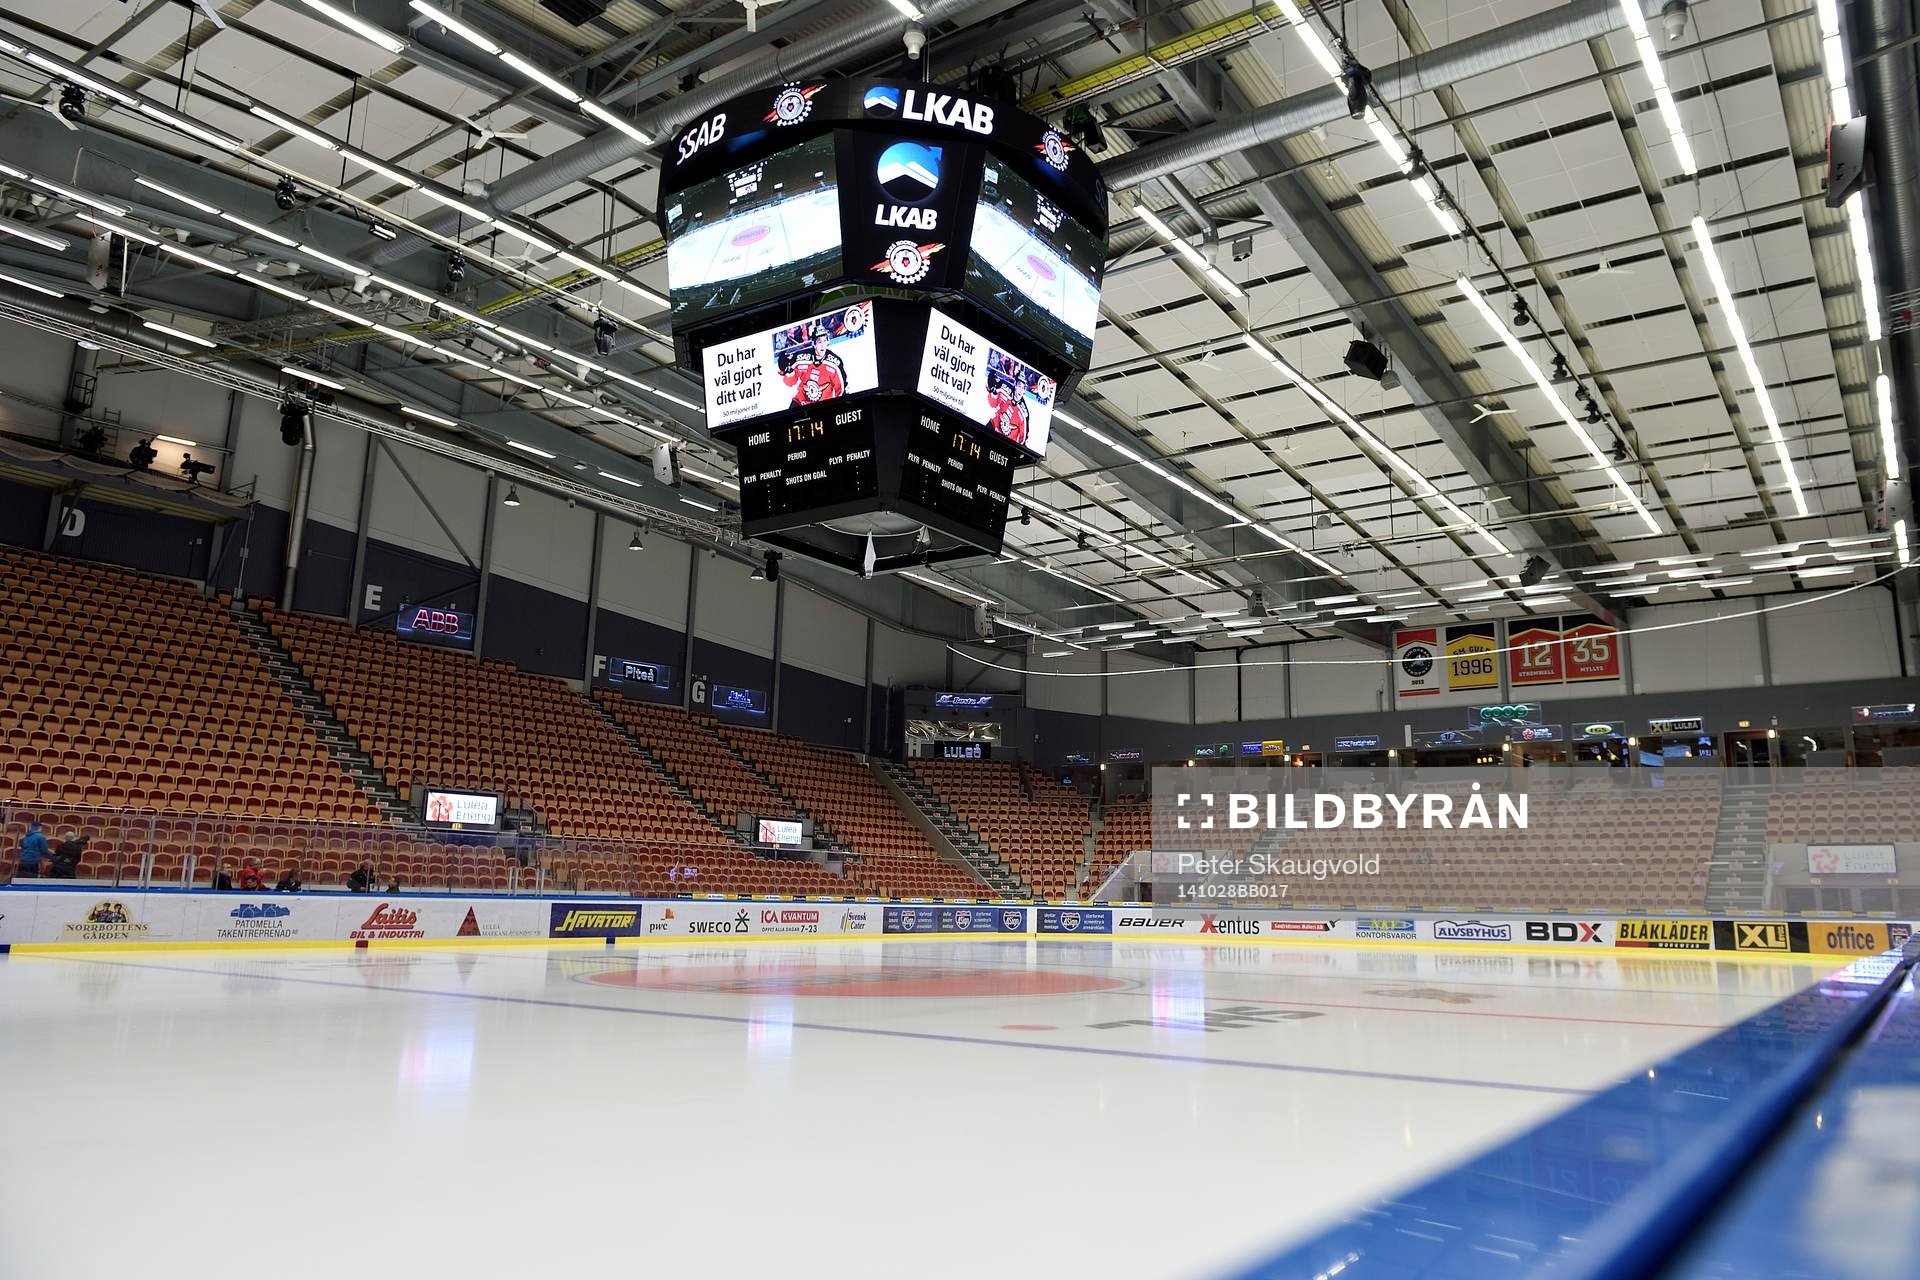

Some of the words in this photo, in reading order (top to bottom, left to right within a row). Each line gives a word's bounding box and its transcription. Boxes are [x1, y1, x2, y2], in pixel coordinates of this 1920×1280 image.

[902, 89, 994, 135] LKAB
[677, 113, 727, 165] SSAB
[875, 204, 938, 230] LKAB
[941, 325, 956, 346] Du
[958, 334, 975, 355] har
[717, 353, 734, 367] Du
[736, 347, 756, 362] har
[934, 345, 950, 362] väl
[950, 355, 976, 378] gjort
[714, 370, 731, 387] väl
[733, 364, 762, 386] gjort
[931, 364, 950, 385] ditt
[952, 376, 972, 395] val?
[716, 388, 736, 406] ditt
[739, 382, 762, 399] val?
[835, 409, 862, 426] GUEST
[920, 415, 941, 434] HOME
[748, 432, 771, 446] HOME
[787, 450, 807, 461] PERIOD
[829, 456, 843, 465] PLYR
[846, 449, 871, 462] PENALTY
[908, 452, 920, 464] PLYR
[921, 459, 941, 474] PENALTY
[947, 457, 964, 471] PERIOD
[989, 450, 1008, 467] GUEST
[744, 474, 757, 484] PLYR
[760, 469, 782, 481] PENALTY
[786, 474, 803, 486] SHOTS
[804, 473, 812, 482] ON
[813, 470, 827, 480] GOAL
[941, 479, 956, 491] SHOTS
[956, 485, 962, 494] ON
[962, 488, 973, 500] GOAL
[977, 484, 987, 495] PLYR
[989, 490, 1007, 503] PENALTY
[61, 506, 85, 537] D
[364, 584, 383, 611] E
[412, 609, 459, 634] ABB
[1521, 640, 1552, 667] 12
[1572, 636, 1609, 663] 35
[593, 654, 607, 677] F
[1452, 658, 1492, 676] 1996
[691, 681, 706, 703] G
[235, 919, 283, 929] PATOMELLA
[361, 903, 417, 929] Laitis
[760, 910, 779, 924] ICA
[782, 911, 818, 922] KVANTUM
[849, 911, 867, 921] Svensk
[850, 920, 865, 930] Cater
[66, 924, 148, 932] NORRBOTTENS
[83, 931, 129, 940] GÅRDEN
[217, 929, 291, 938] TAKENTREPRENAD
[350, 930, 366, 939] BIL
[368, 930, 376, 939] &
[378, 930, 425, 938] INDUSTRI
[649, 922, 668, 933] pwc
[689, 921, 732, 933] SWECO
[800, 924, 818, 933] 7-23
[1356, 931, 1417, 940] KONTORSVAROR
[1525, 921, 1604, 943] BDX
[1620, 920, 1709, 941] BLÅKLÄDER
[1738, 924, 1782, 949] XL
[1827, 926, 1875, 950] office
